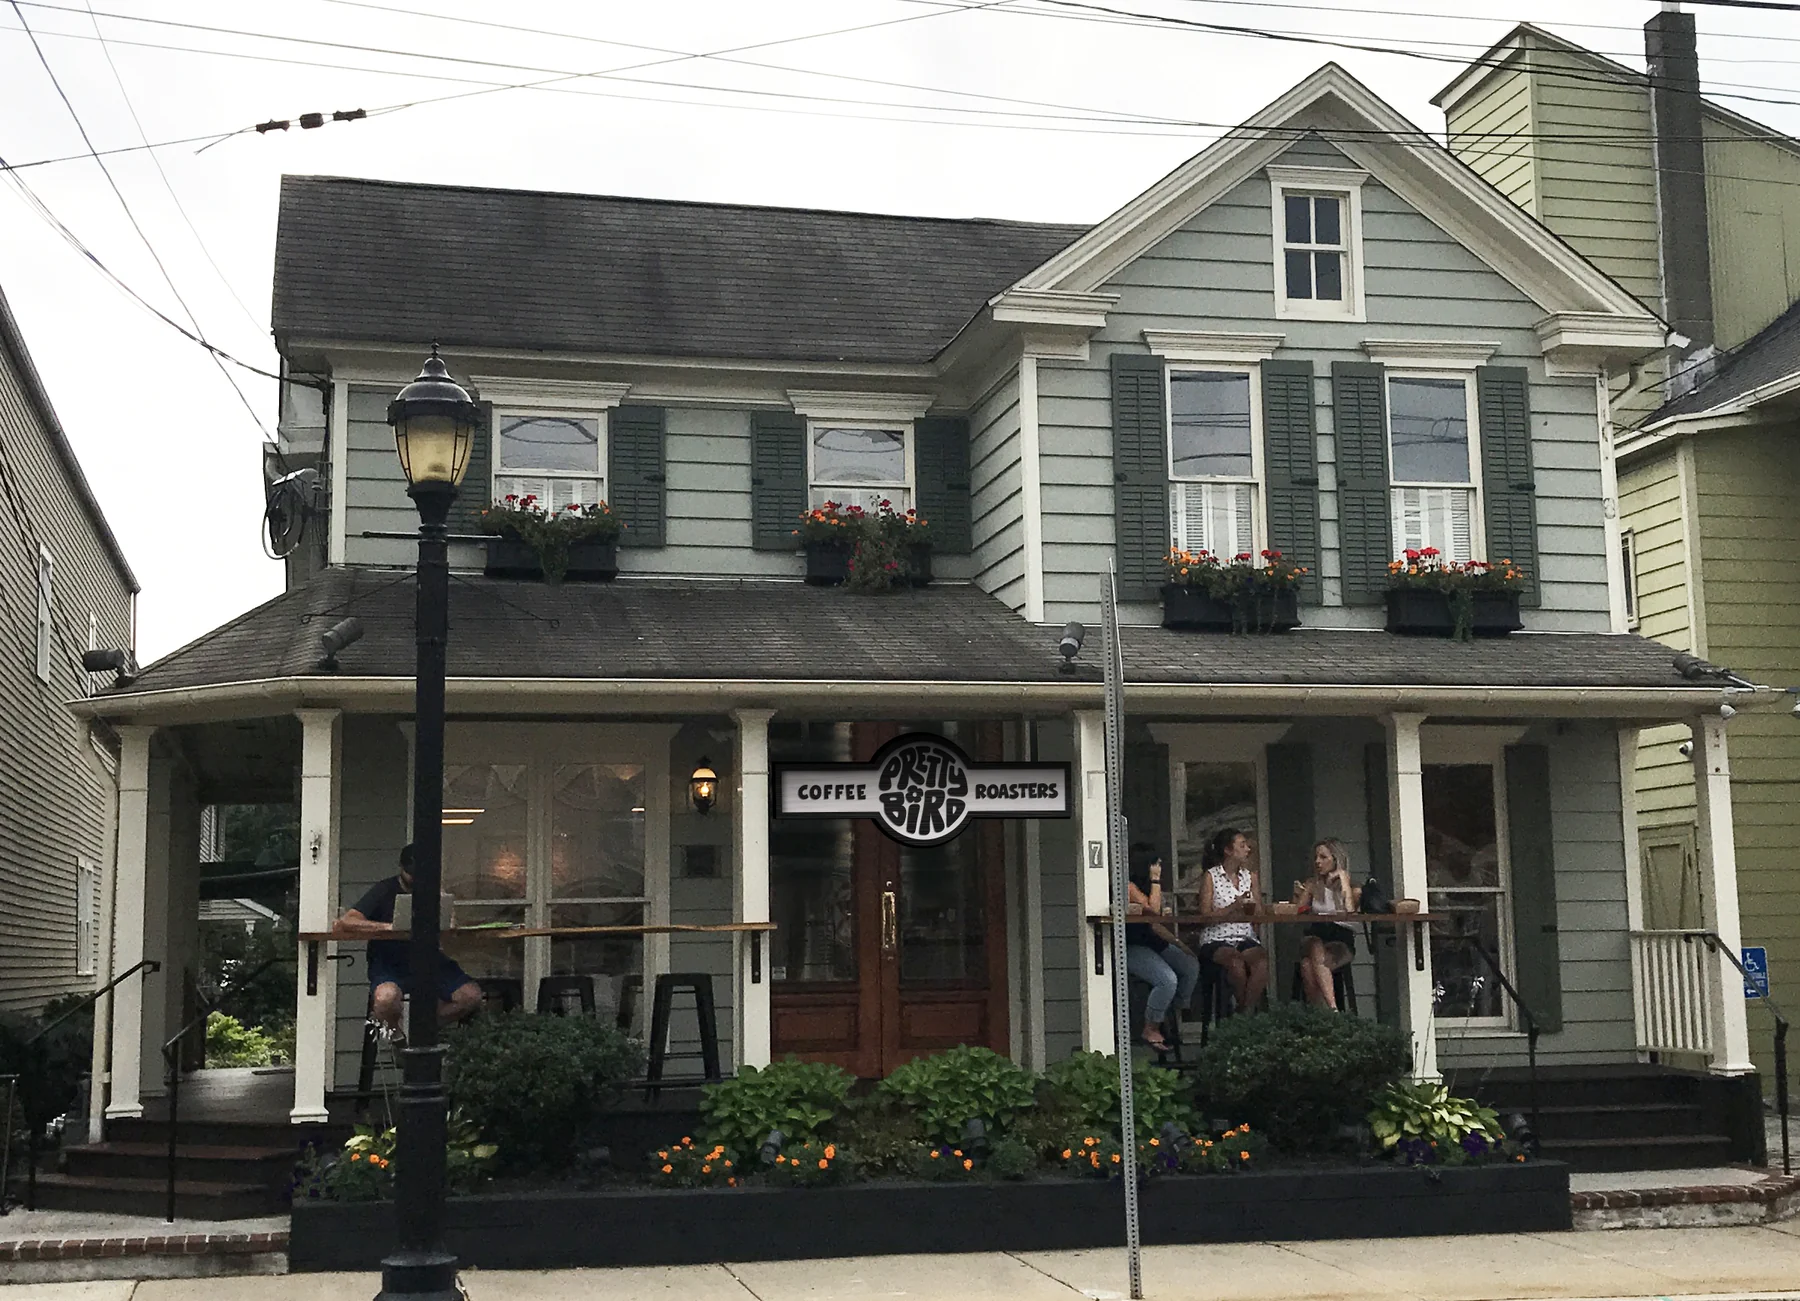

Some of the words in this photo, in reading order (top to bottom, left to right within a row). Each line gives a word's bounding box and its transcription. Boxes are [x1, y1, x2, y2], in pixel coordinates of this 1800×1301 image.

[878, 746, 968, 797] PRETTY
[797, 784, 866, 800] COFFEE
[975, 782, 1059, 800] ROASTERS
[879, 787, 966, 836] BIRD
[1091, 843, 1101, 865] 7
